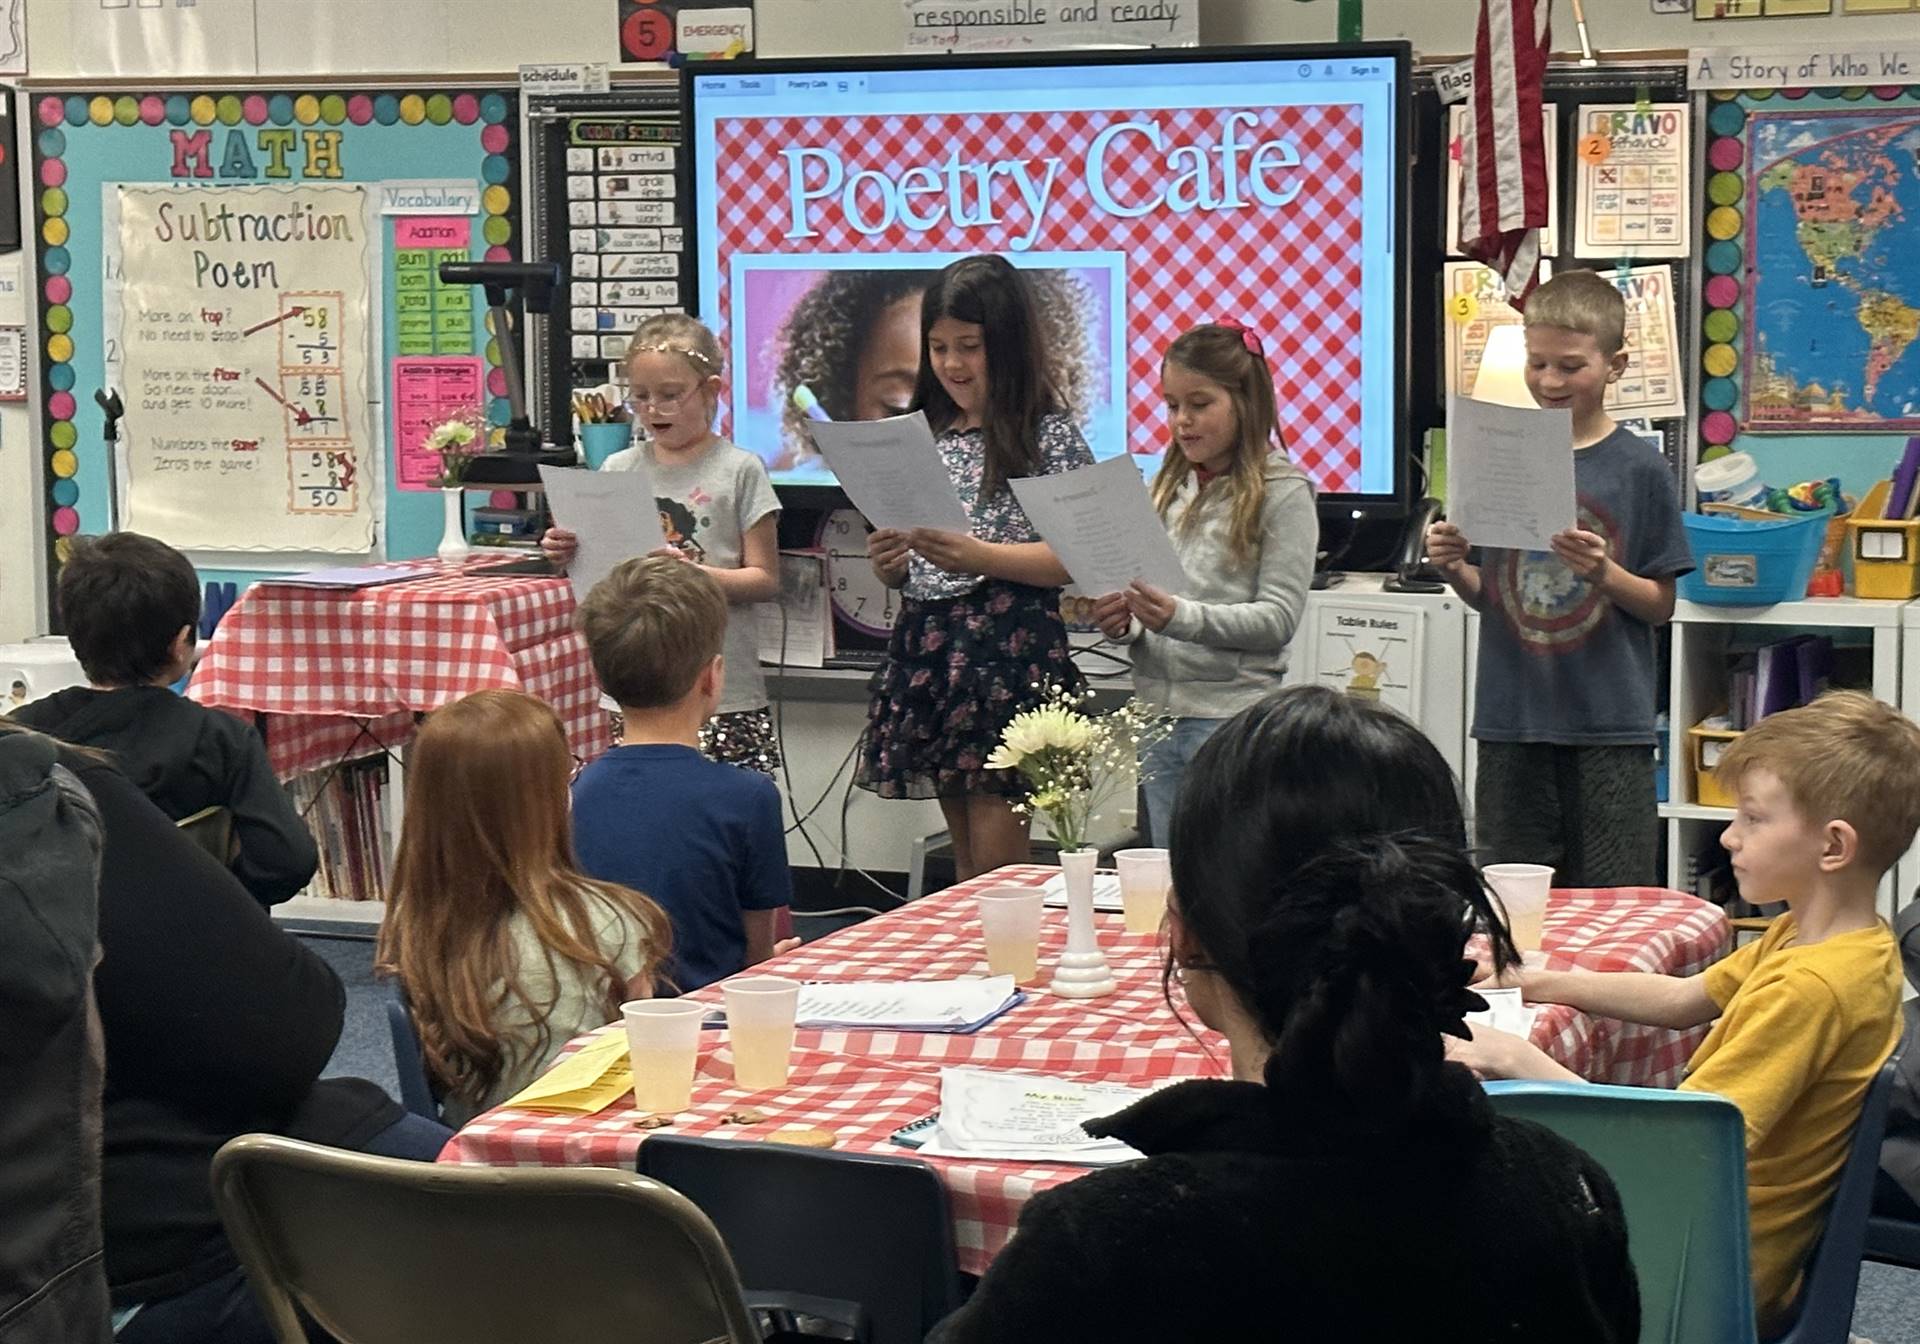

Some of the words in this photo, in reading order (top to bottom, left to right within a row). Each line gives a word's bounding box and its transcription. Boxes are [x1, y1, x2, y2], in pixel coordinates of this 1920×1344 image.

[914, 0, 1046, 37] responsible
[1060, 0, 1098, 22] and
[1112, 0, 1180, 31] ready
[639, 20, 655, 47] 5
[683, 25, 746, 37] EMERGENCY
[522, 68, 578, 82] schedule
[1697, 57, 1713, 80] A
[1730, 56, 1788, 85] Story
[1798, 54, 1820, 79] of
[1829, 53, 1868, 77] Who
[1880, 52, 1909, 75] We
[1440, 72, 1472, 91] flag
[1596, 111, 1677, 137] BRAVO
[170, 129, 344, 179] MATH
[1589, 139, 1602, 155] 2
[628, 151, 665, 163] arrival
[778, 148, 1062, 251] Poetry
[1086, 111, 1304, 218] Cafe
[384, 187, 472, 213] Vocabulary
[155, 202, 354, 243] Subtraction
[193, 250, 279, 289] Poem
[1457, 298, 1470, 316] 3
[138, 309, 172, 323] More
[177, 312, 194, 323] on
[303, 306, 328, 329] 58
[138, 330, 157, 342] No
[162, 329, 191, 342] need
[193, 330, 205, 342] to
[319, 331, 329, 346] 5
[302, 349, 330, 365] 53
[142, 368, 172, 382] More
[174, 371, 190, 382] on
[192, 368, 211, 382] the
[143, 383, 162, 396] Go
[165, 383, 195, 396] next
[141, 398, 167, 410] and
[170, 399, 192, 415] get
[200, 398, 212, 410] 10
[151, 436, 208, 451] Numbers
[210, 437, 230, 451] the
[193, 457, 212, 471] the
[311, 451, 336, 469] 58
[311, 490, 338, 507] 50
[835, 520, 850, 535] 10
[838, 576, 847, 591] 8
[856, 597, 867, 611] 7
[1336, 615, 1367, 628] Table
[1369, 617, 1399, 630] Rules
